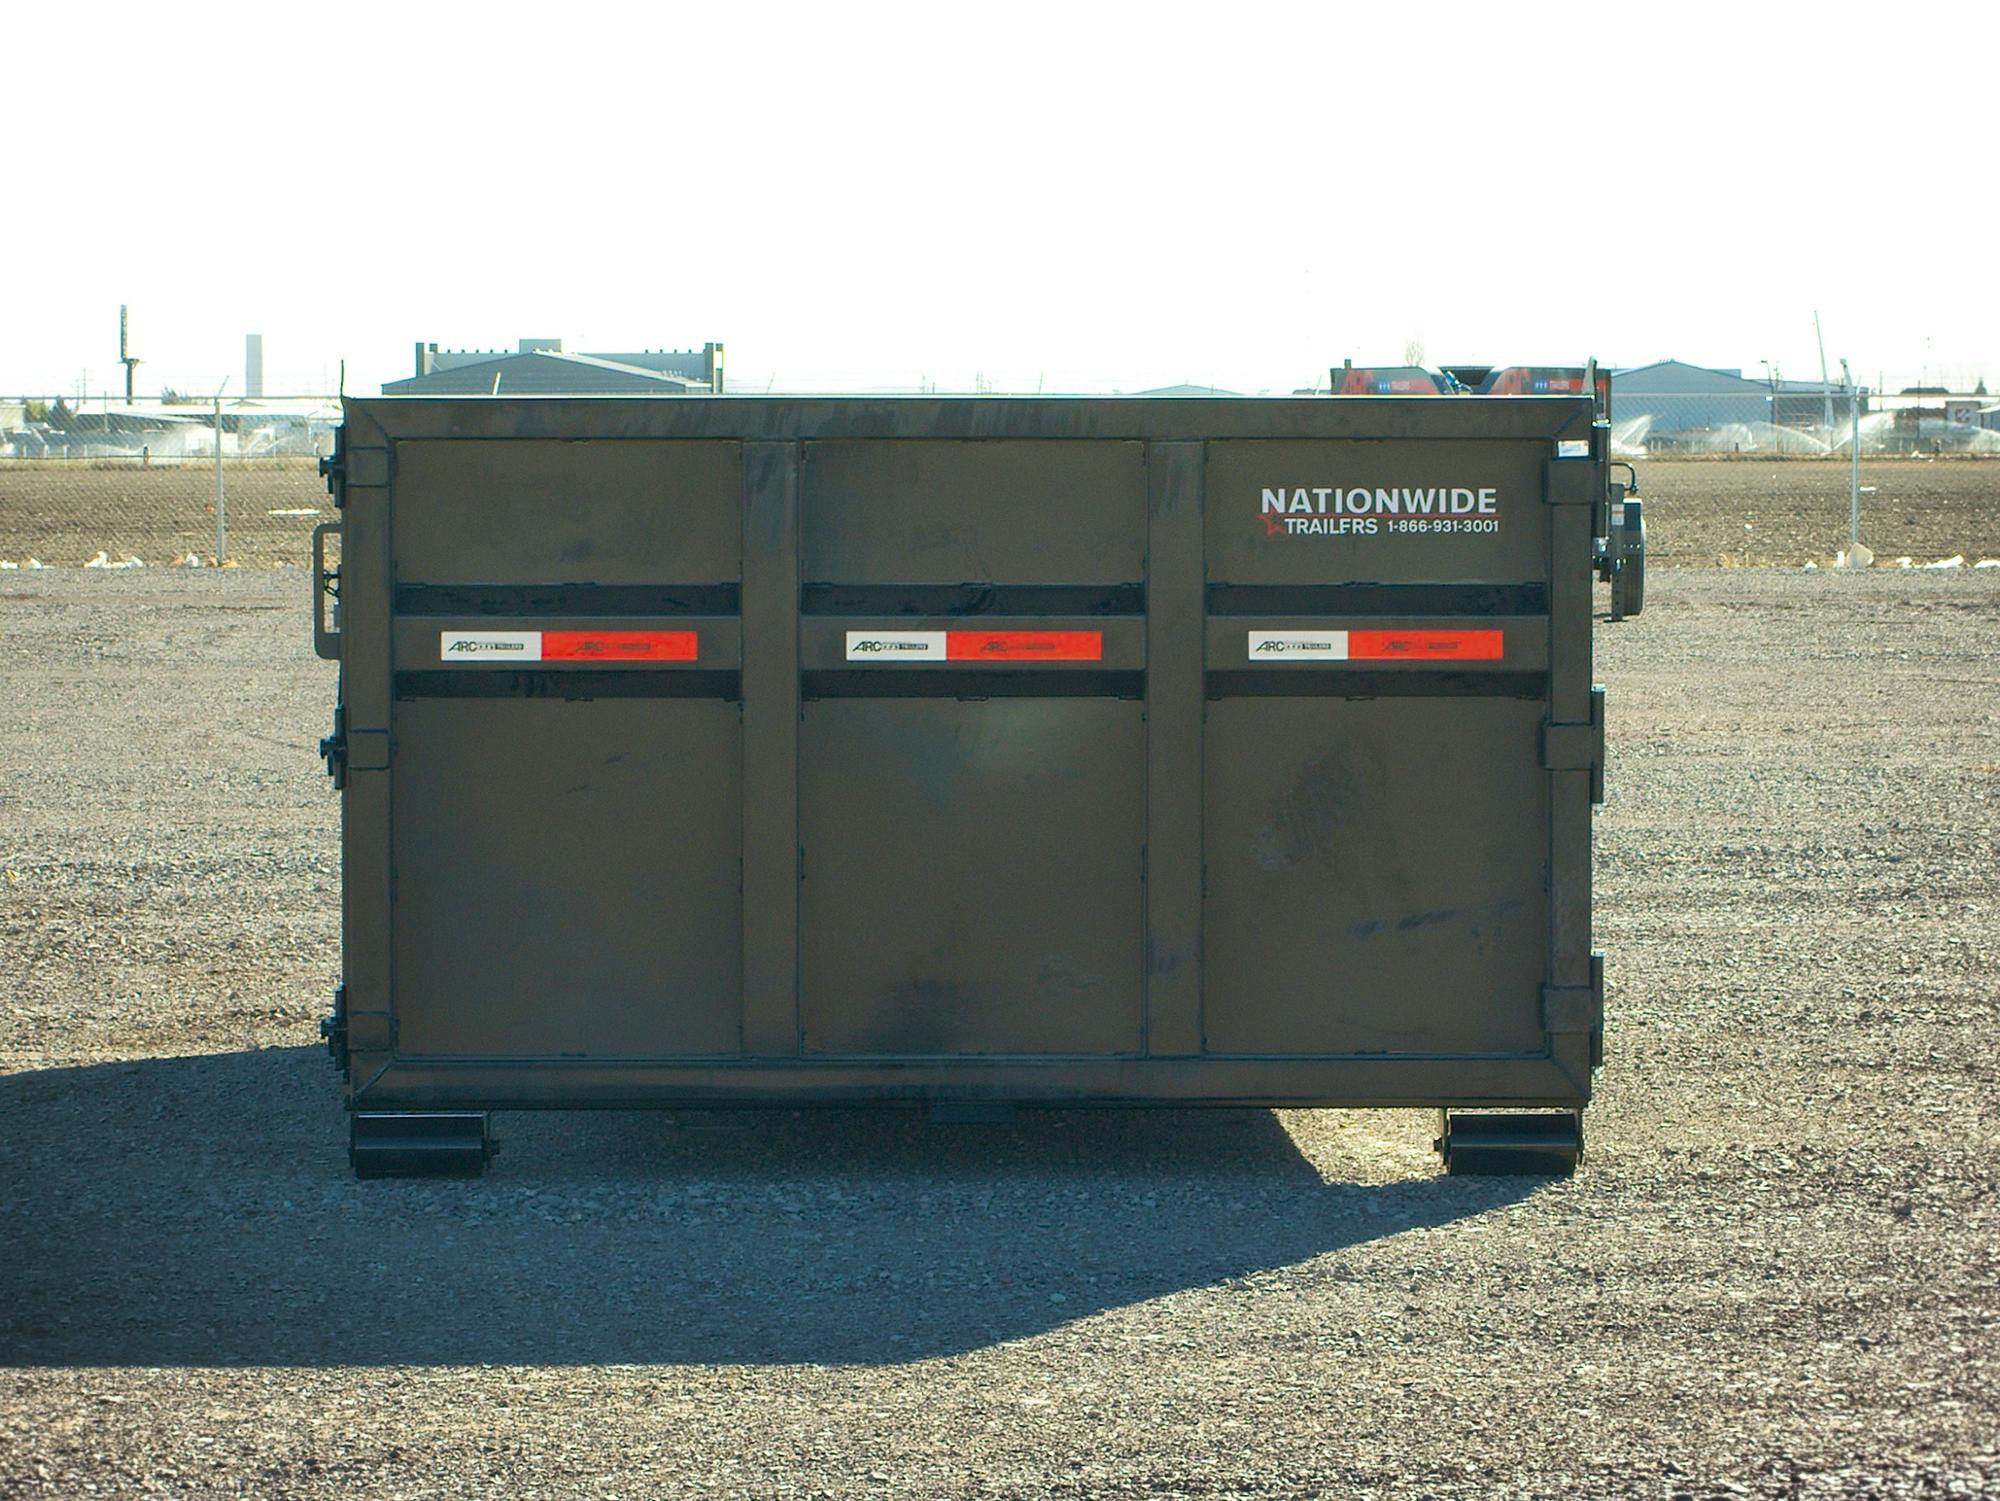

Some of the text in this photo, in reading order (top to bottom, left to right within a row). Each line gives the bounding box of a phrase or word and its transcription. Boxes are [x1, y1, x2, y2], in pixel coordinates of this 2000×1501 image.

[1261, 488, 1497, 513] NATIONWIDE
[1284, 518, 1498, 534] TRAILERS 1-866-931-3001
[448, 641, 478, 652] ARC
[852, 641, 882, 652] ARC
[1255, 641, 1286, 652] ARC
